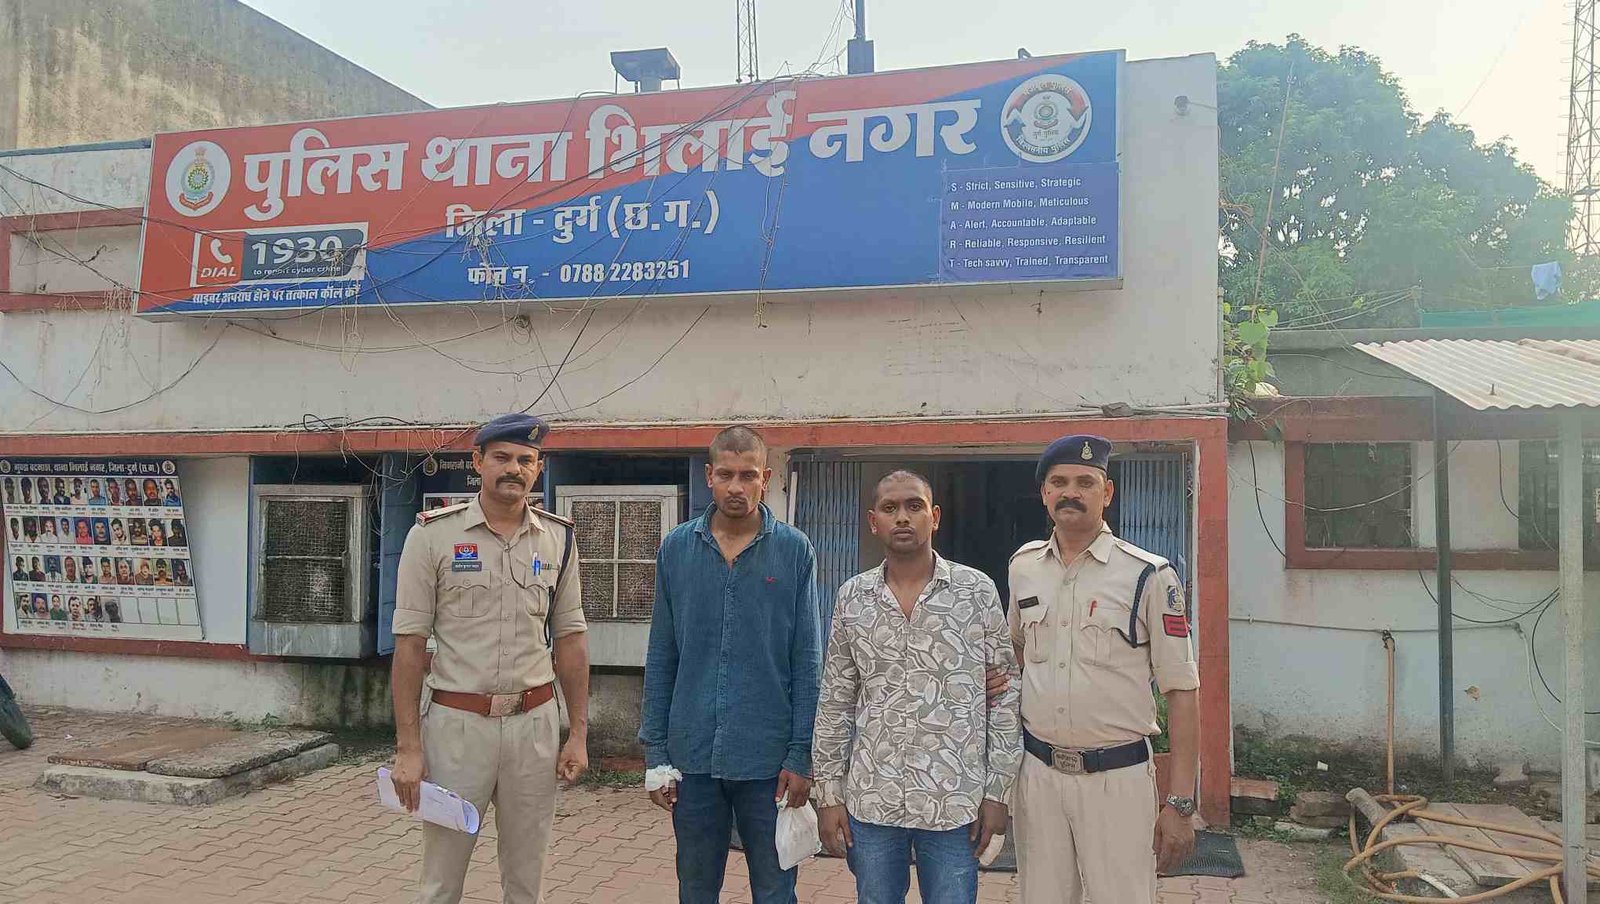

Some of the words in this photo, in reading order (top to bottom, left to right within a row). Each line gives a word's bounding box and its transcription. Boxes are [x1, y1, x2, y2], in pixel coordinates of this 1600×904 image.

[244, 128, 410, 221] पुलिस
[420, 131, 573, 187] थाना
[585, 90, 798, 178] भिलाई
[807, 99, 982, 162] नगर
[951, 183, 957, 192] S
[966, 182, 991, 191] Strict,
[994, 179, 1038, 189] Sensitive,
[1041, 177, 1082, 189] Strategic
[951, 202, 959, 210] M
[967, 201, 1000, 210] Modern
[1003, 199, 1036, 208] Mobile,
[1039, 197, 1089, 206] Meticulous
[445, 203, 527, 238] जिला
[553, 196, 602, 244] दुर्ग
[950, 221, 956, 230] A
[965, 220, 988, 229] Alert,
[991, 217, 1048, 228] Accountable,
[1051, 215, 1096, 226] Adaptable
[950, 240, 956, 248] R
[965, 238, 1005, 248] Reliable,
[1007, 236, 1061, 247] Responsive,
[1065, 235, 1105, 245] Resilient
[201, 266, 237, 278] DIAL
[252, 235, 343, 265] 1930
[950, 259, 955, 267] T
[963, 258, 983, 267] Tech
[985, 258, 1012, 268] savvy,
[1016, 256, 1052, 266] Trained,
[1055, 254, 1109, 265] Transparent
[291, 267, 315, 275] cyber
[560, 264, 605, 283] 0788
[610, 260, 689, 282] 2283251
[193, 293, 220, 305] साइबर
[221, 291, 252, 303] अपराध
[254, 288, 270, 301] होने
[273, 290, 284, 300] पर
[286, 289, 319, 300] तत्काल
[321, 286, 343, 298] कॉल
